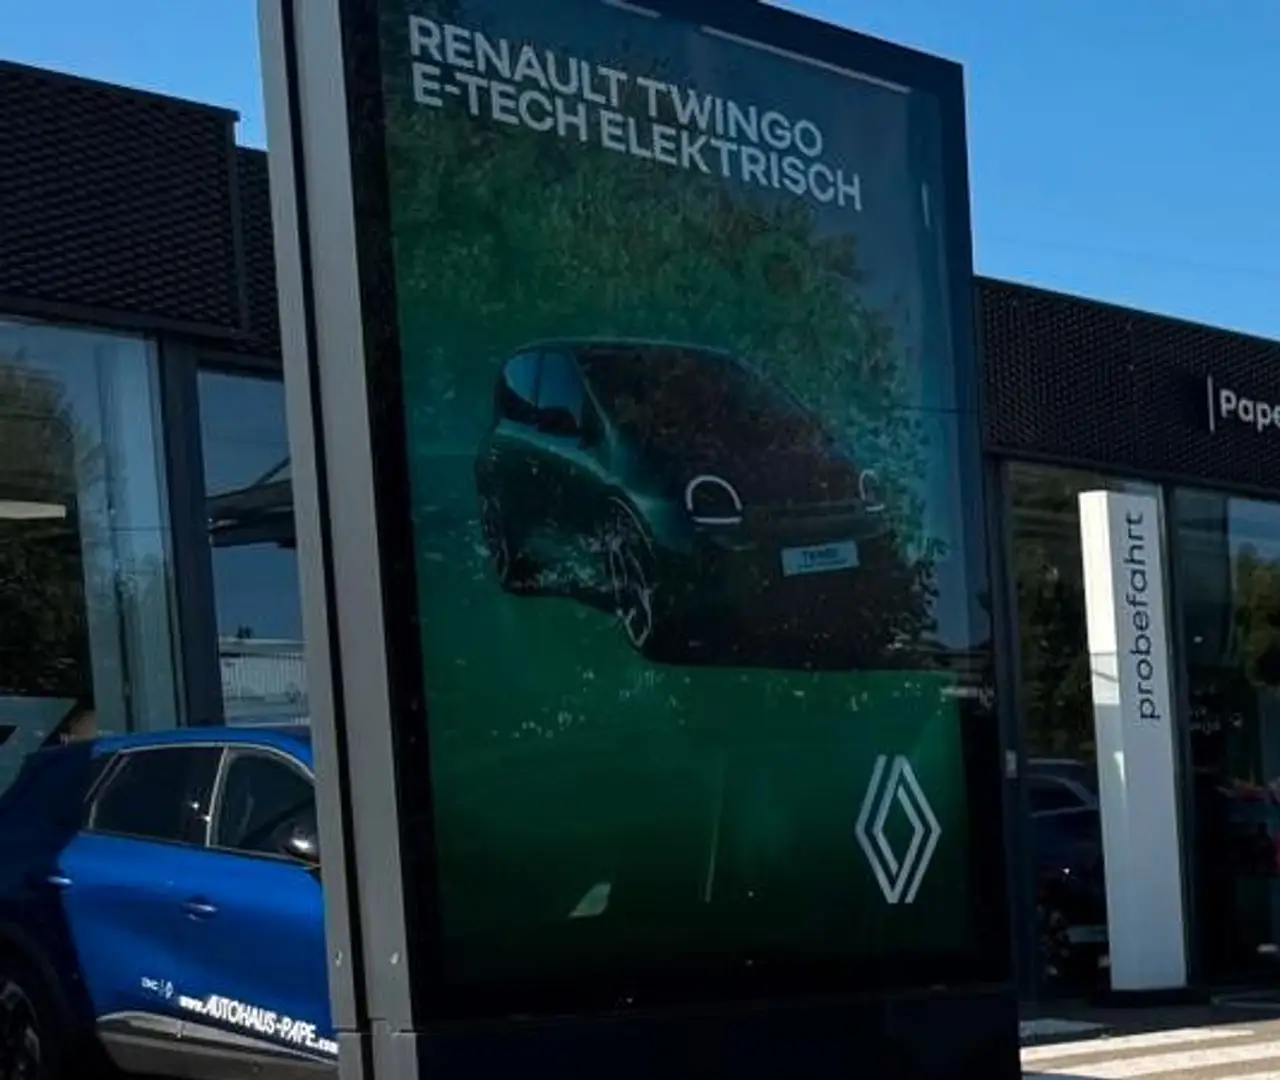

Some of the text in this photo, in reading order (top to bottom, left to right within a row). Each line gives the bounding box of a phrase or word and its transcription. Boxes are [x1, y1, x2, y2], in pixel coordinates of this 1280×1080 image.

[408, 14, 824, 158] RENAULT TWINGO
[411, 62, 863, 211] E-TECH ELEKTRISCH
[1123, 512, 1161, 720] probefahrt
